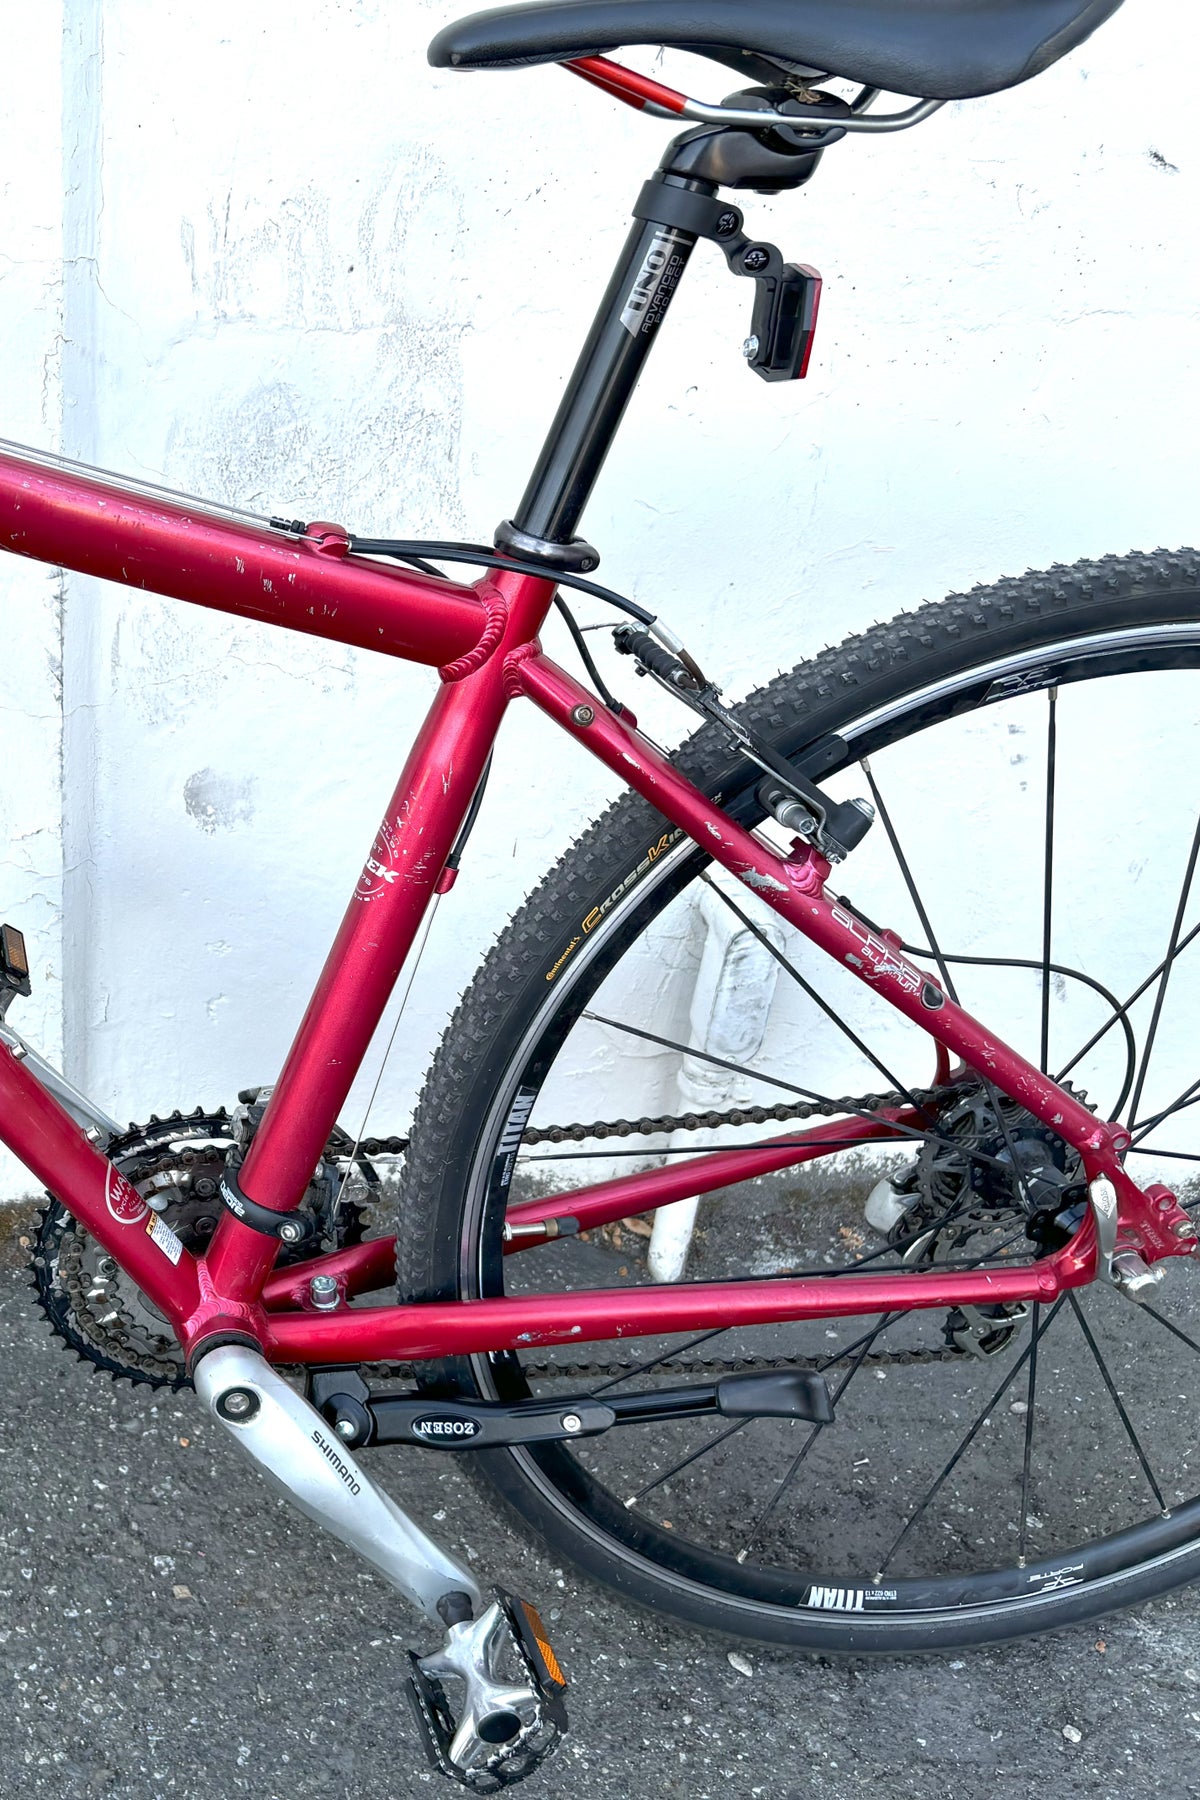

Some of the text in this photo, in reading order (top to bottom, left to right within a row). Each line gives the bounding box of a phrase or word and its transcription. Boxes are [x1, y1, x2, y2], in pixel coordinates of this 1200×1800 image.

[628, 249, 668, 312] UNO
[545, 940, 577, 981] Continental
[497, 1094, 537, 1156] TITAN
[220, 1180, 246, 1217] Deore
[419, 1421, 475, 1435] ZOSEN
[311, 1430, 361, 1496] SHIMANO
[808, 1586, 865, 1611] TITAN
